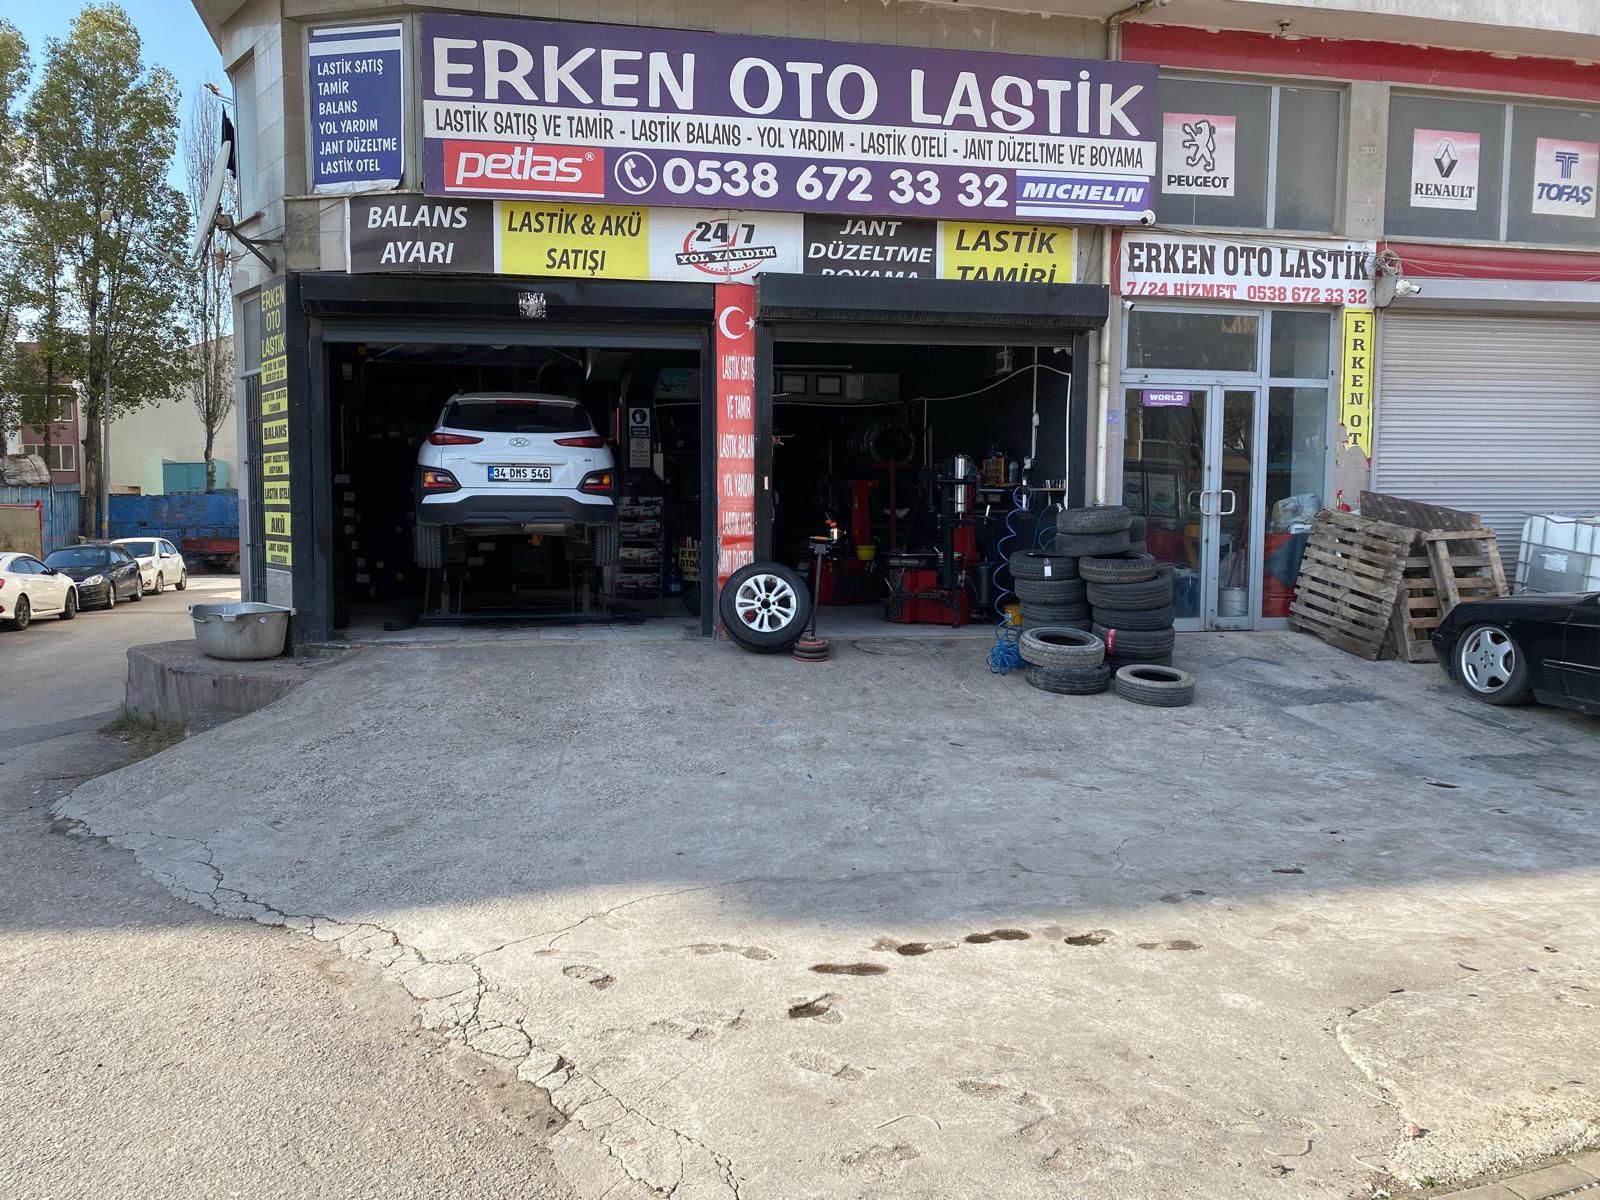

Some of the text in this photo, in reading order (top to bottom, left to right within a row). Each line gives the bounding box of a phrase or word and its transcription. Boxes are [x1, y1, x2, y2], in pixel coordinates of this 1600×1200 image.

[317, 58, 383, 76] LASTİK SATIŞ
[318, 78, 349, 95] TAMİR
[434, 37, 1144, 137] ERKEN OTO LASTİK
[319, 100, 358, 115] BALANS
[319, 119, 378, 134] YOL YARDIM
[435, 105, 486, 133] LASTİK
[494, 110, 537, 141] SATIŞ
[542, 115, 561, 136] VE
[567, 111, 614, 140] TAMİR
[631, 115, 681, 142] LASTİK
[686, 121, 741, 147] BALANS
[758, 126, 784, 149] YOL
[789, 128, 844, 152] YARDIM
[860, 129, 907, 157] LASTİK
[911, 132, 947, 158] OTELİ
[962, 138, 993, 162] JANT
[1000, 136, 1064, 165] DÜZELTME
[1069, 144, 1085, 166] VE
[1091, 145, 1143, 169] BOYAMA
[320, 137, 397, 156] JANT DÜZELTME
[321, 158, 380, 175] LASTİK OTEL
[663, 157, 1009, 208] 0538 672 33 32
[1021, 182, 1145, 203] MICHELIN
[1167, 174, 1229, 189] PEUGEOT
[1414, 183, 1475, 199] RENAULT
[1537, 182, 1594, 205] TOFAŞ
[368, 205, 468, 229] BALANS
[507, 208, 642, 237] LASTİK & AKÜ
[840, 219, 903, 237] JANT
[808, 240, 933, 263] DÜZELTME
[955, 226, 1058, 254] LASTİK
[380, 241, 455, 264] AYARI
[545, 248, 606, 276] SATIŞI
[678, 248, 776, 264] YOL YARDIM
[1127, 241, 1369, 281] ERKEN OTO LASTİK
[957, 262, 1057, 283] TAMİRİ
[261, 283, 285, 312] ERKEN
[1126, 279, 1367, 304] 7/24 HİZMET 0538 672 33 32
[266, 308, 281, 331] OTO
[261, 328, 286, 358] LASTİK
[722, 350, 740, 380] LASTİK
[264, 424, 287, 440] BALANS
[494, 468, 549, 479] 34 DMS 546
